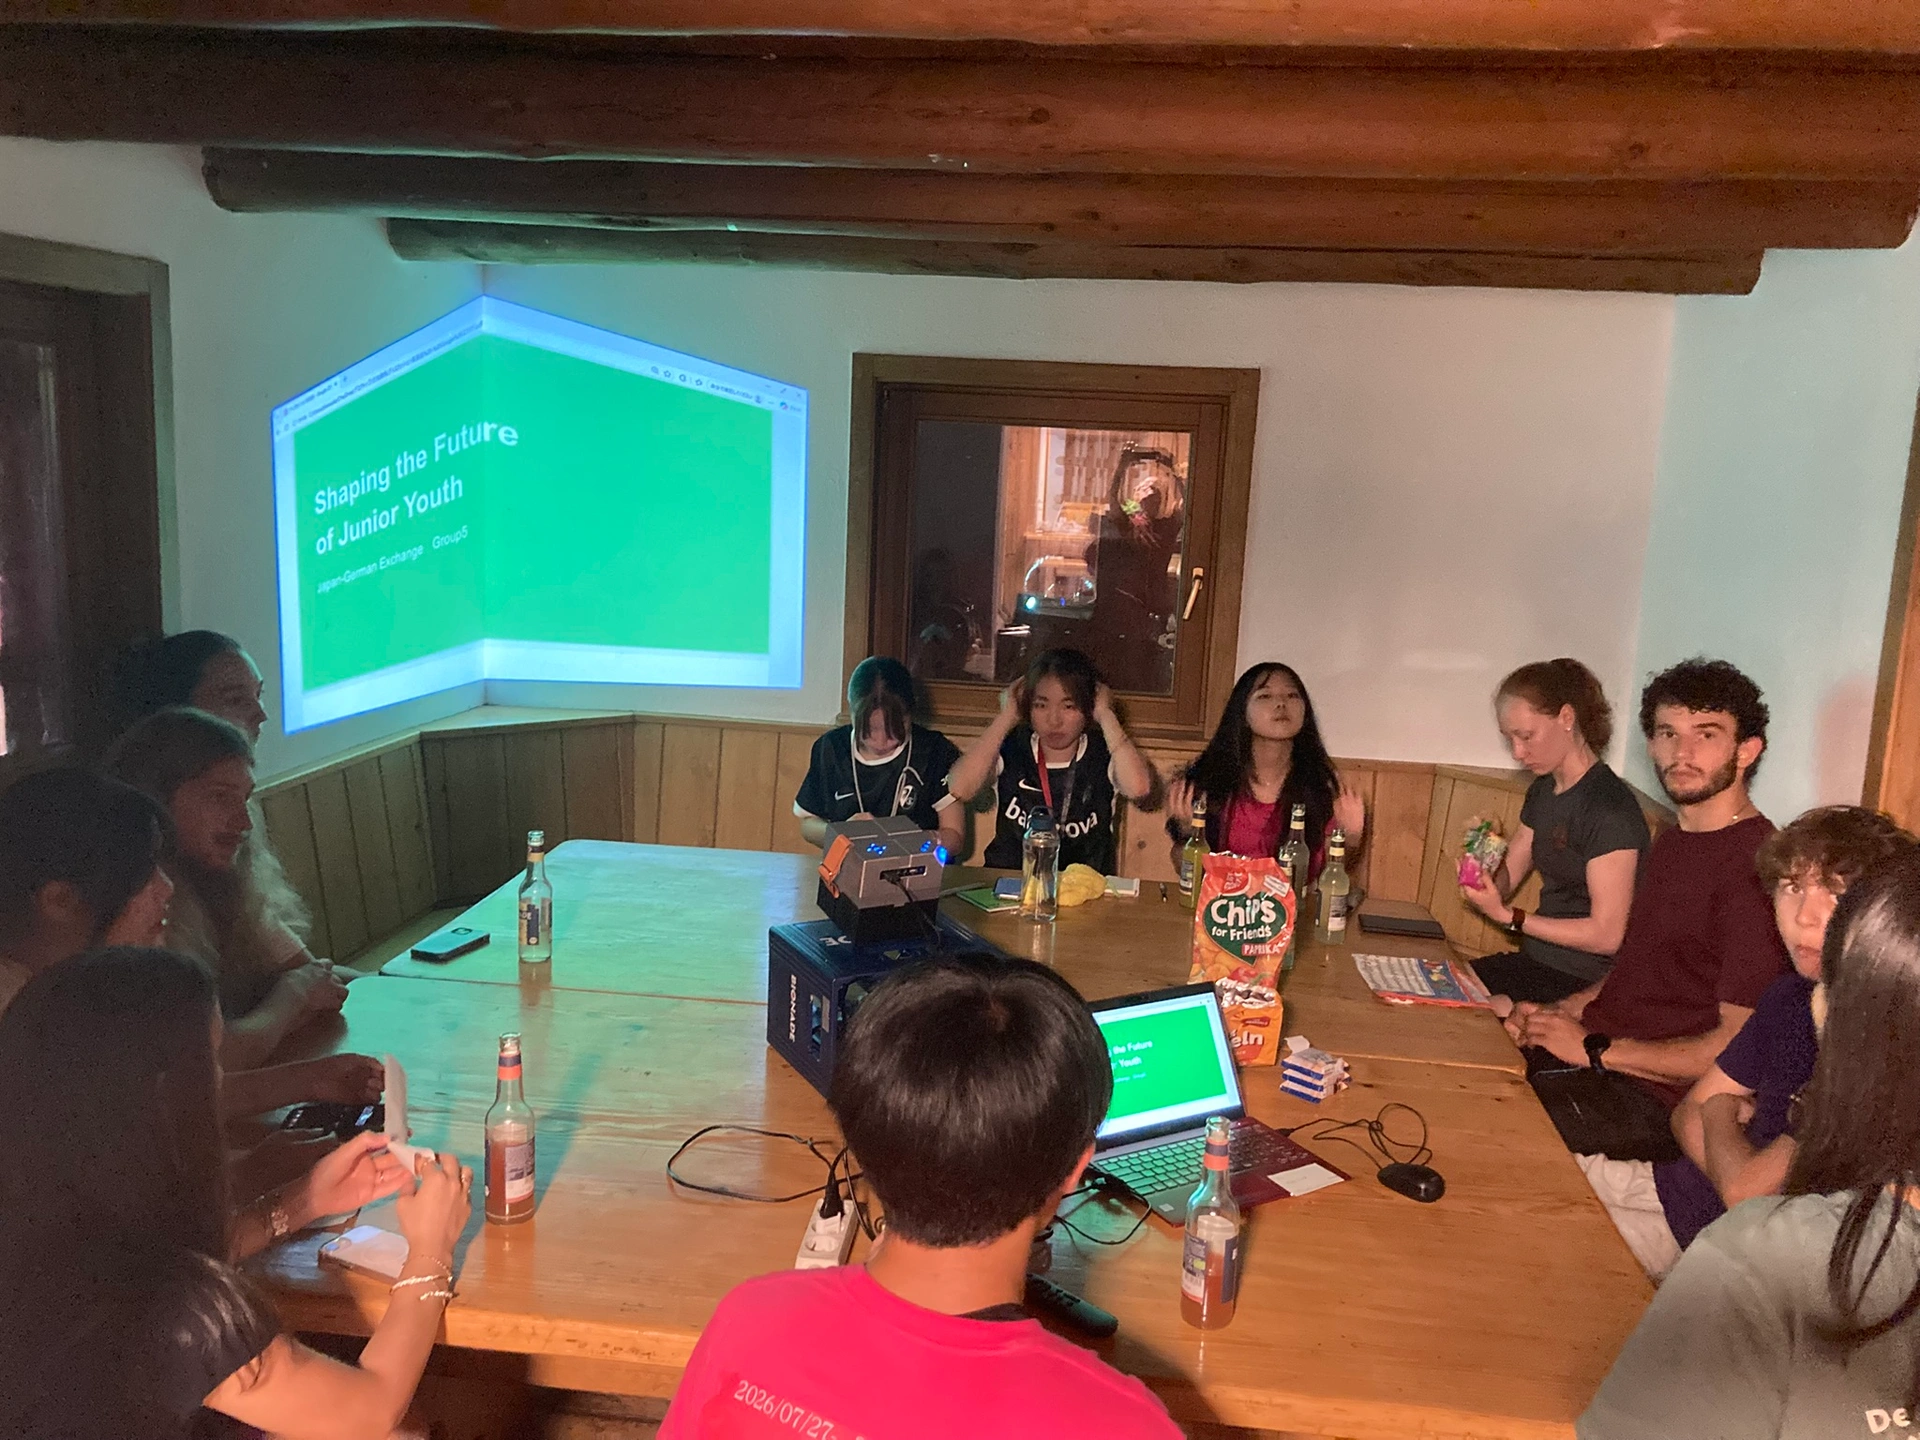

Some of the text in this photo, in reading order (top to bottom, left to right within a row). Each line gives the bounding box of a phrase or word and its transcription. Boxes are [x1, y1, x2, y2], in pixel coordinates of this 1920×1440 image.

[314, 421, 519, 515] Shaping the Future
[316, 474, 463, 555] of Junior Youth
[317, 525, 469, 594] Japan-German Exchange Group5
[1005, 796, 1098, 838] baova
[1211, 925, 1272, 941] for Friends
[1244, 944, 1280, 955] PAPRIKA
[788, 973, 797, 1044] BIONADE
